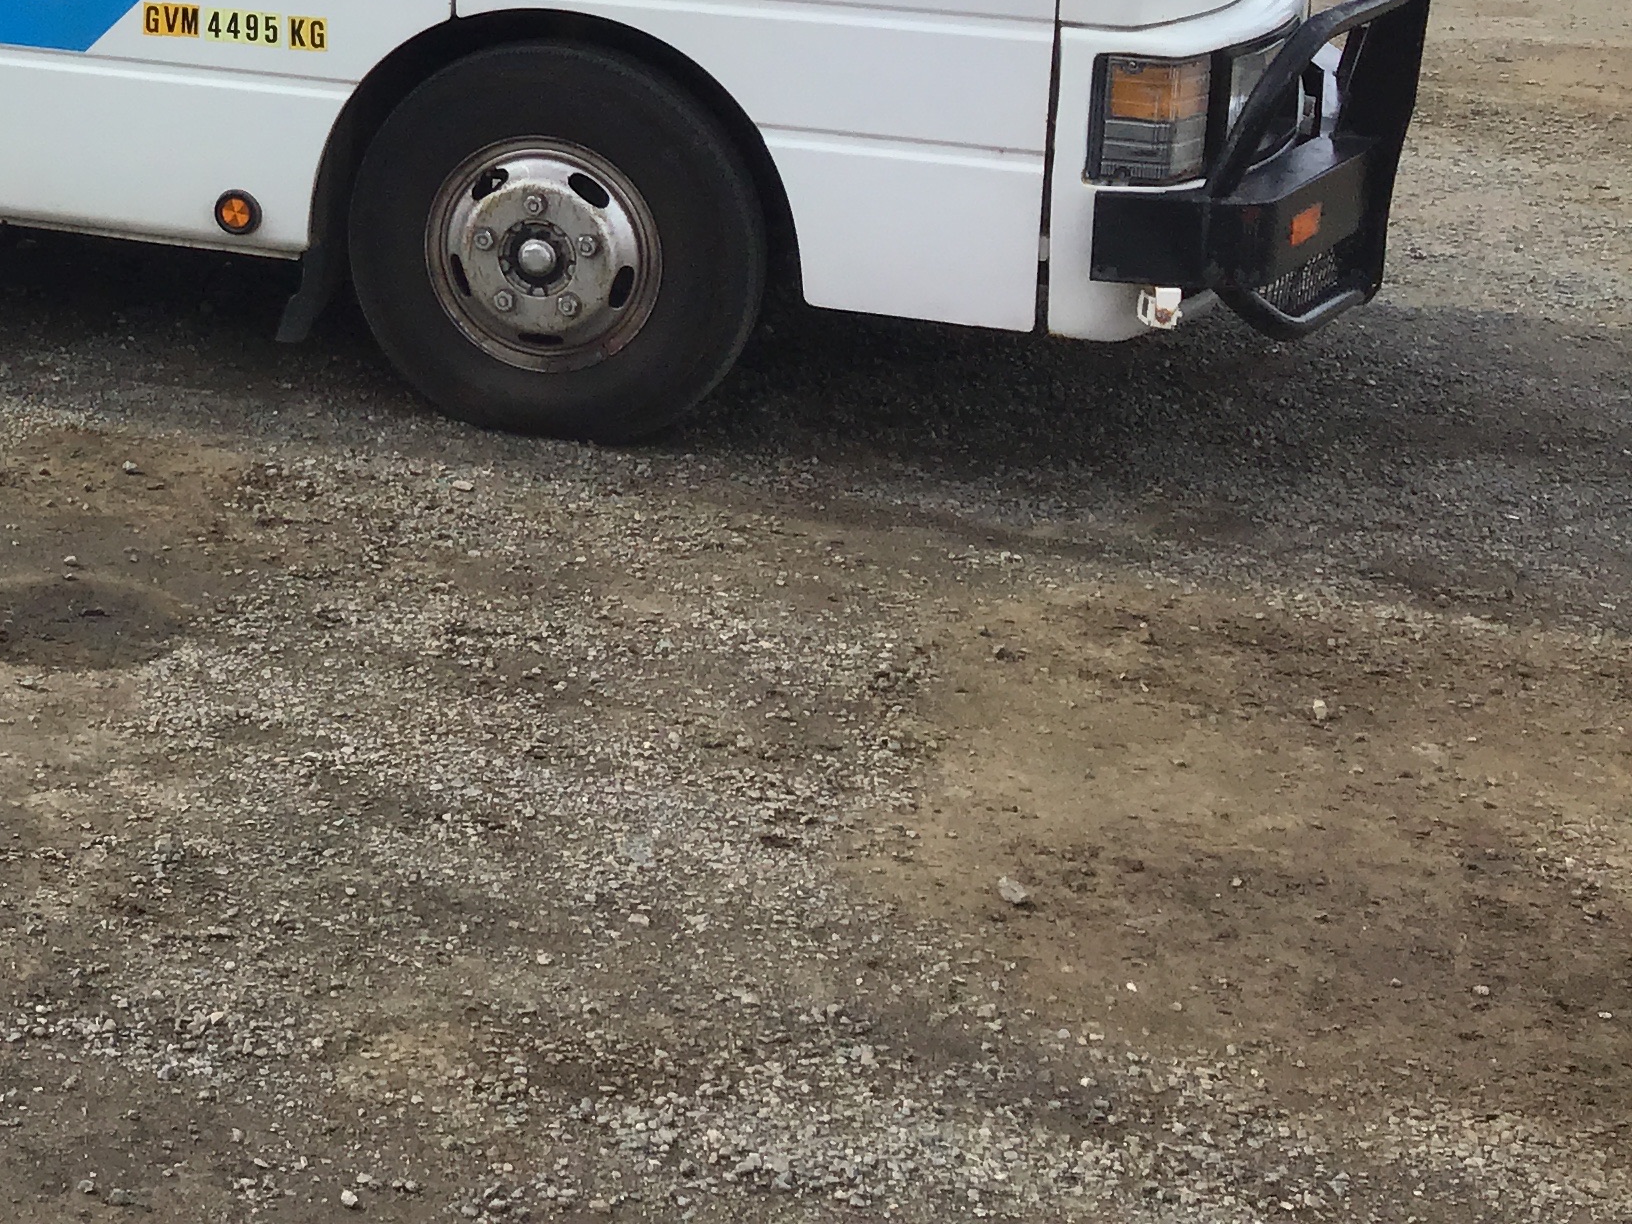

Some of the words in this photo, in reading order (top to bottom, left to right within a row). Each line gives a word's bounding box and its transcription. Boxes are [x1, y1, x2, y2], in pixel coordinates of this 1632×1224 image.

[145, 5, 199, 35] GVM
[207, 10, 278, 44] 4495
[290, 18, 325, 49] KG
